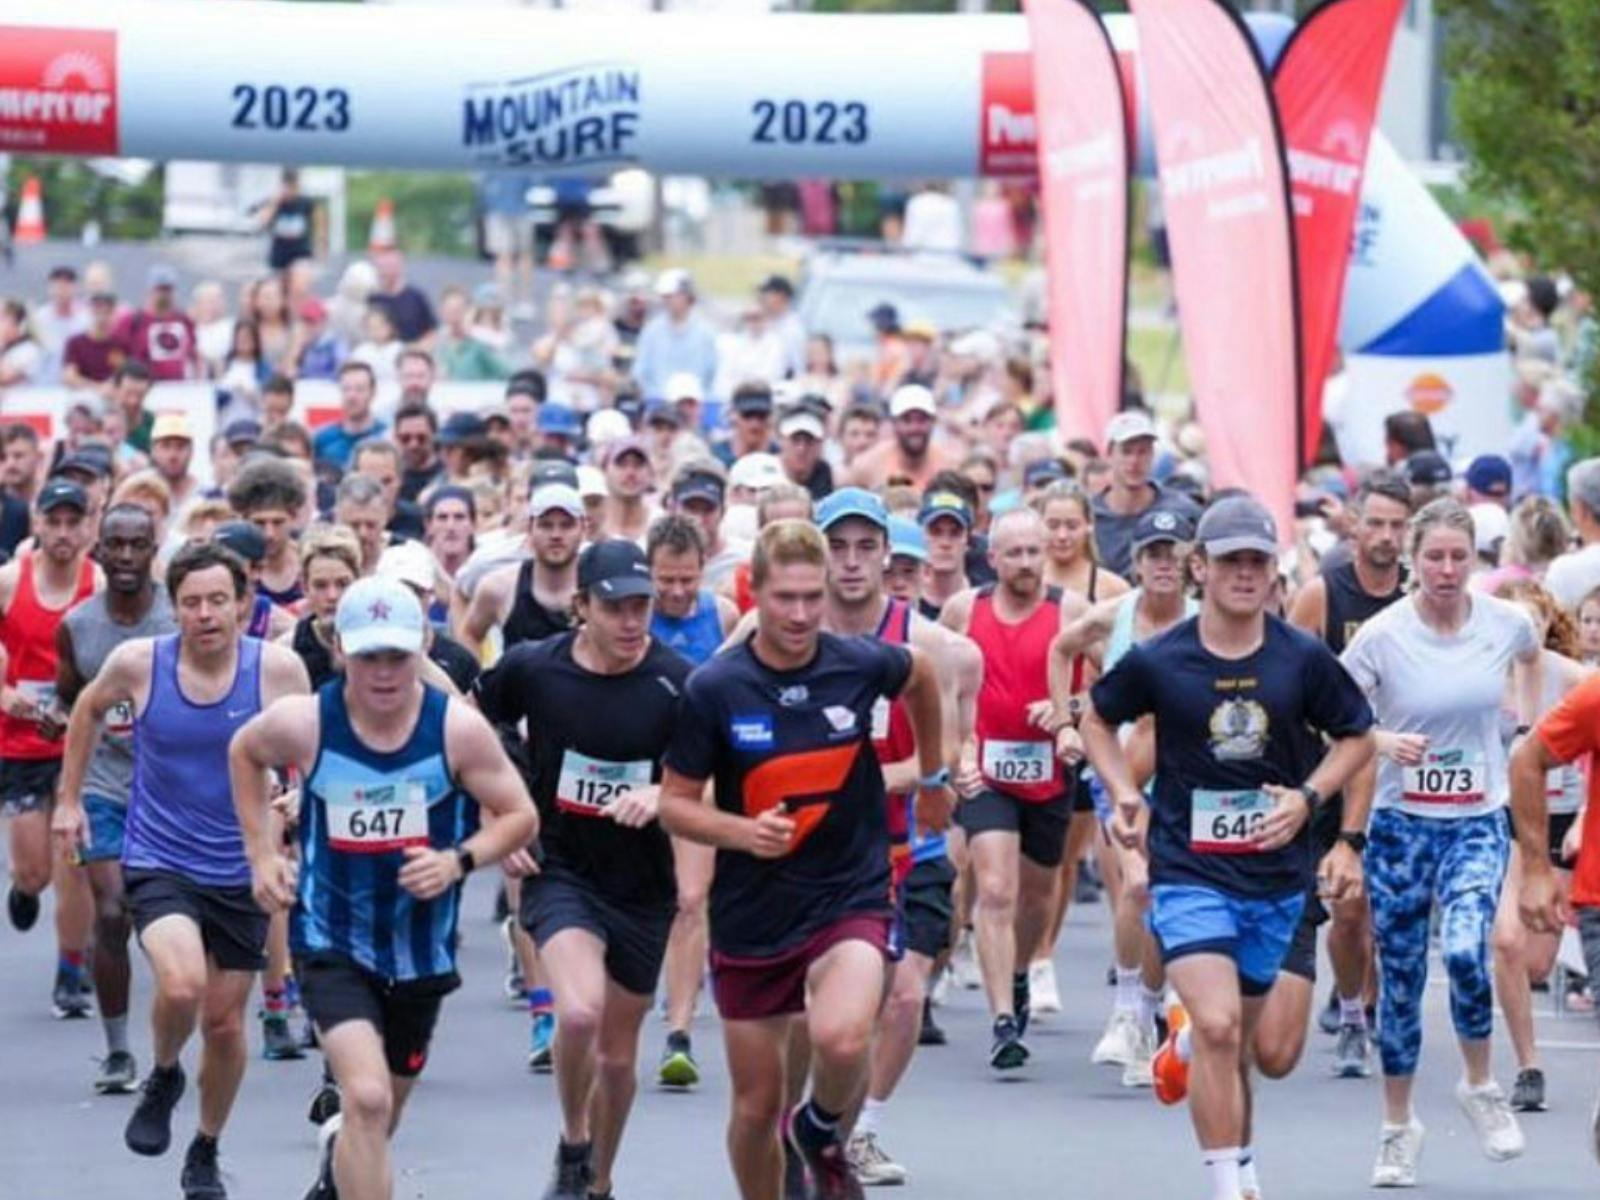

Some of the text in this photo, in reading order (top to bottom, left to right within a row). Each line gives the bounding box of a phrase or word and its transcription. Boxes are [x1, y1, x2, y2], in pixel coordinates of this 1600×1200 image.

[232, 84, 350, 131] 2023
[462, 70, 640, 146] MOUNTAIN
[752, 100, 868, 145] 2023
[506, 111, 640, 167] SURF
[994, 760, 1044, 780] 1023
[1416, 768, 1473, 793] 1073
[348, 807, 405, 838] 647
